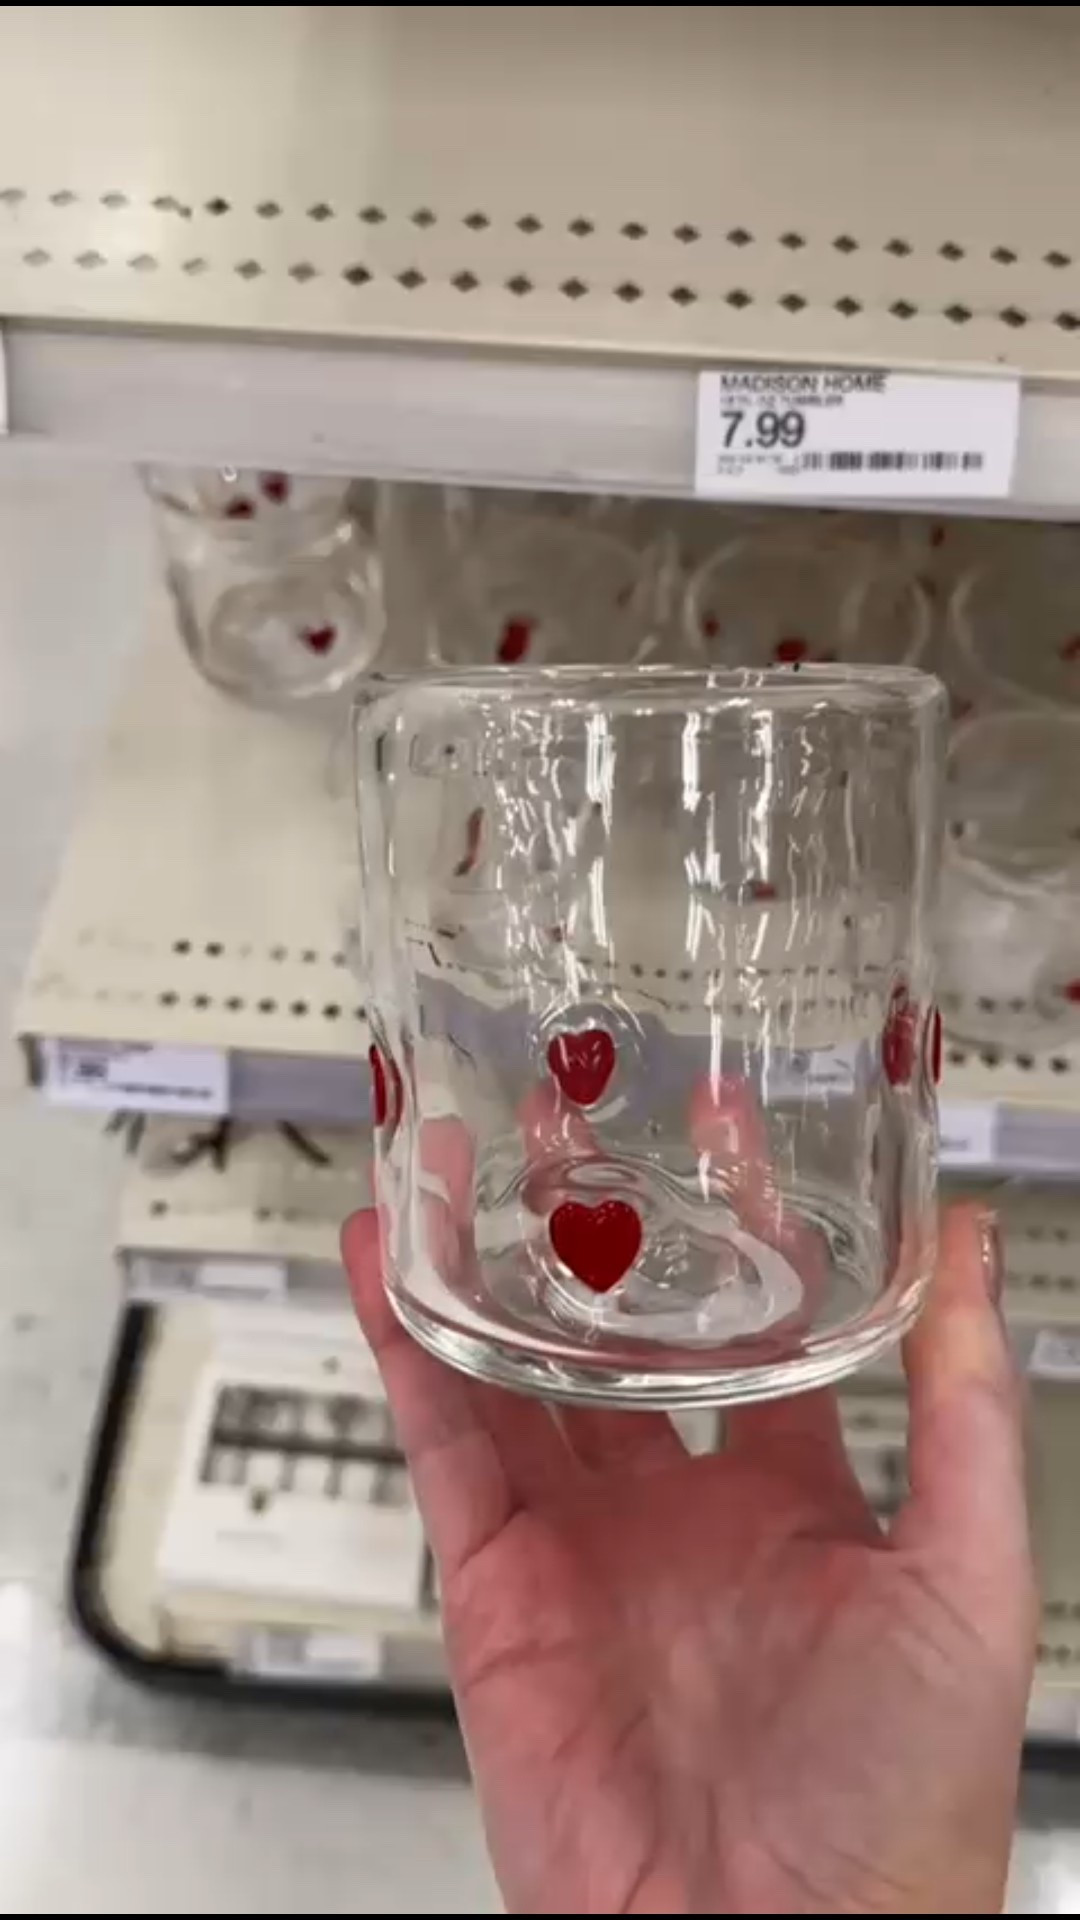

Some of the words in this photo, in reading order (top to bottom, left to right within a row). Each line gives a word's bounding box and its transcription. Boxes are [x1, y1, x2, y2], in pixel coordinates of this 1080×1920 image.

[720, 374, 818, 394] MADISON
[822, 374, 887, 394] HOME
[720, 410, 806, 448] 7.99
